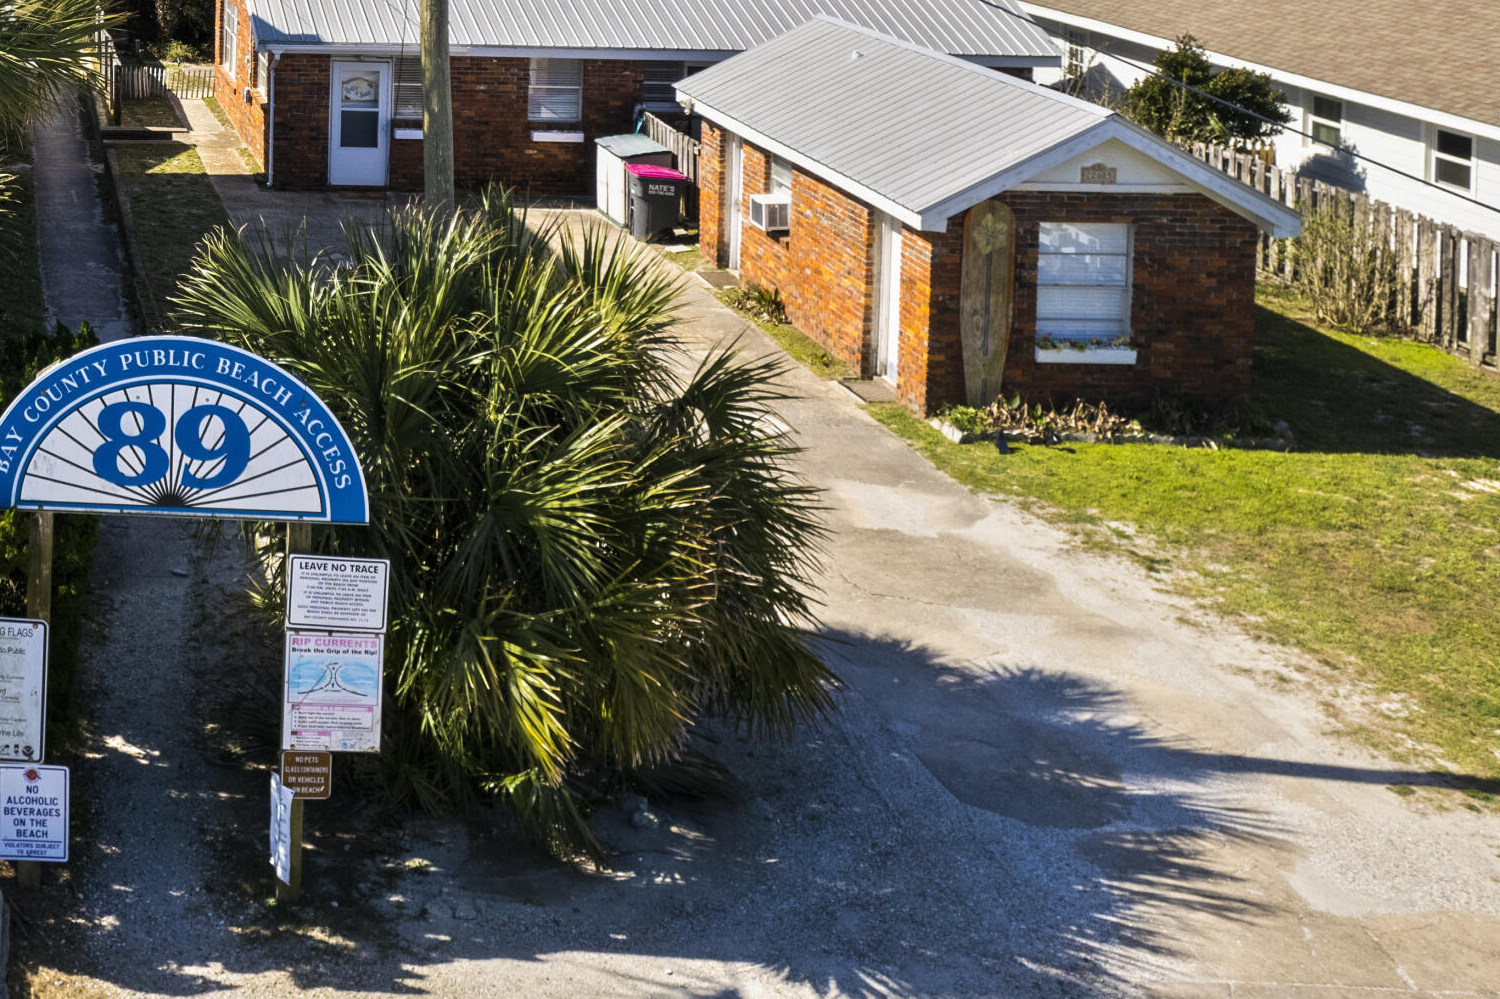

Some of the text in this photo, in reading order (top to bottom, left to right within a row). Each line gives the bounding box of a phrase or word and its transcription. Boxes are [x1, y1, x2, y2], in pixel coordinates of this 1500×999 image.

[23, 359, 108, 423] COUNTY
[118, 349, 206, 371] PUBLIC
[216, 357, 293, 407] BEACH
[293, 408, 352, 489] ACCESS
[92, 401, 251, 489] 89
[300, 561, 378, 573] LEAVE NO TRACE
[8, 628, 33, 638] FLAGS
[292, 637, 377, 648] RIP CURRENTS
[8, 647, 26, 655] Public
[26, 786, 38, 794] NO
[6, 796, 58, 806] ALCOHOLIC
[4, 807, 60, 817] BEVERAGES
[13, 818, 47, 827] ON THE
[16, 829, 48, 838] BEACH
